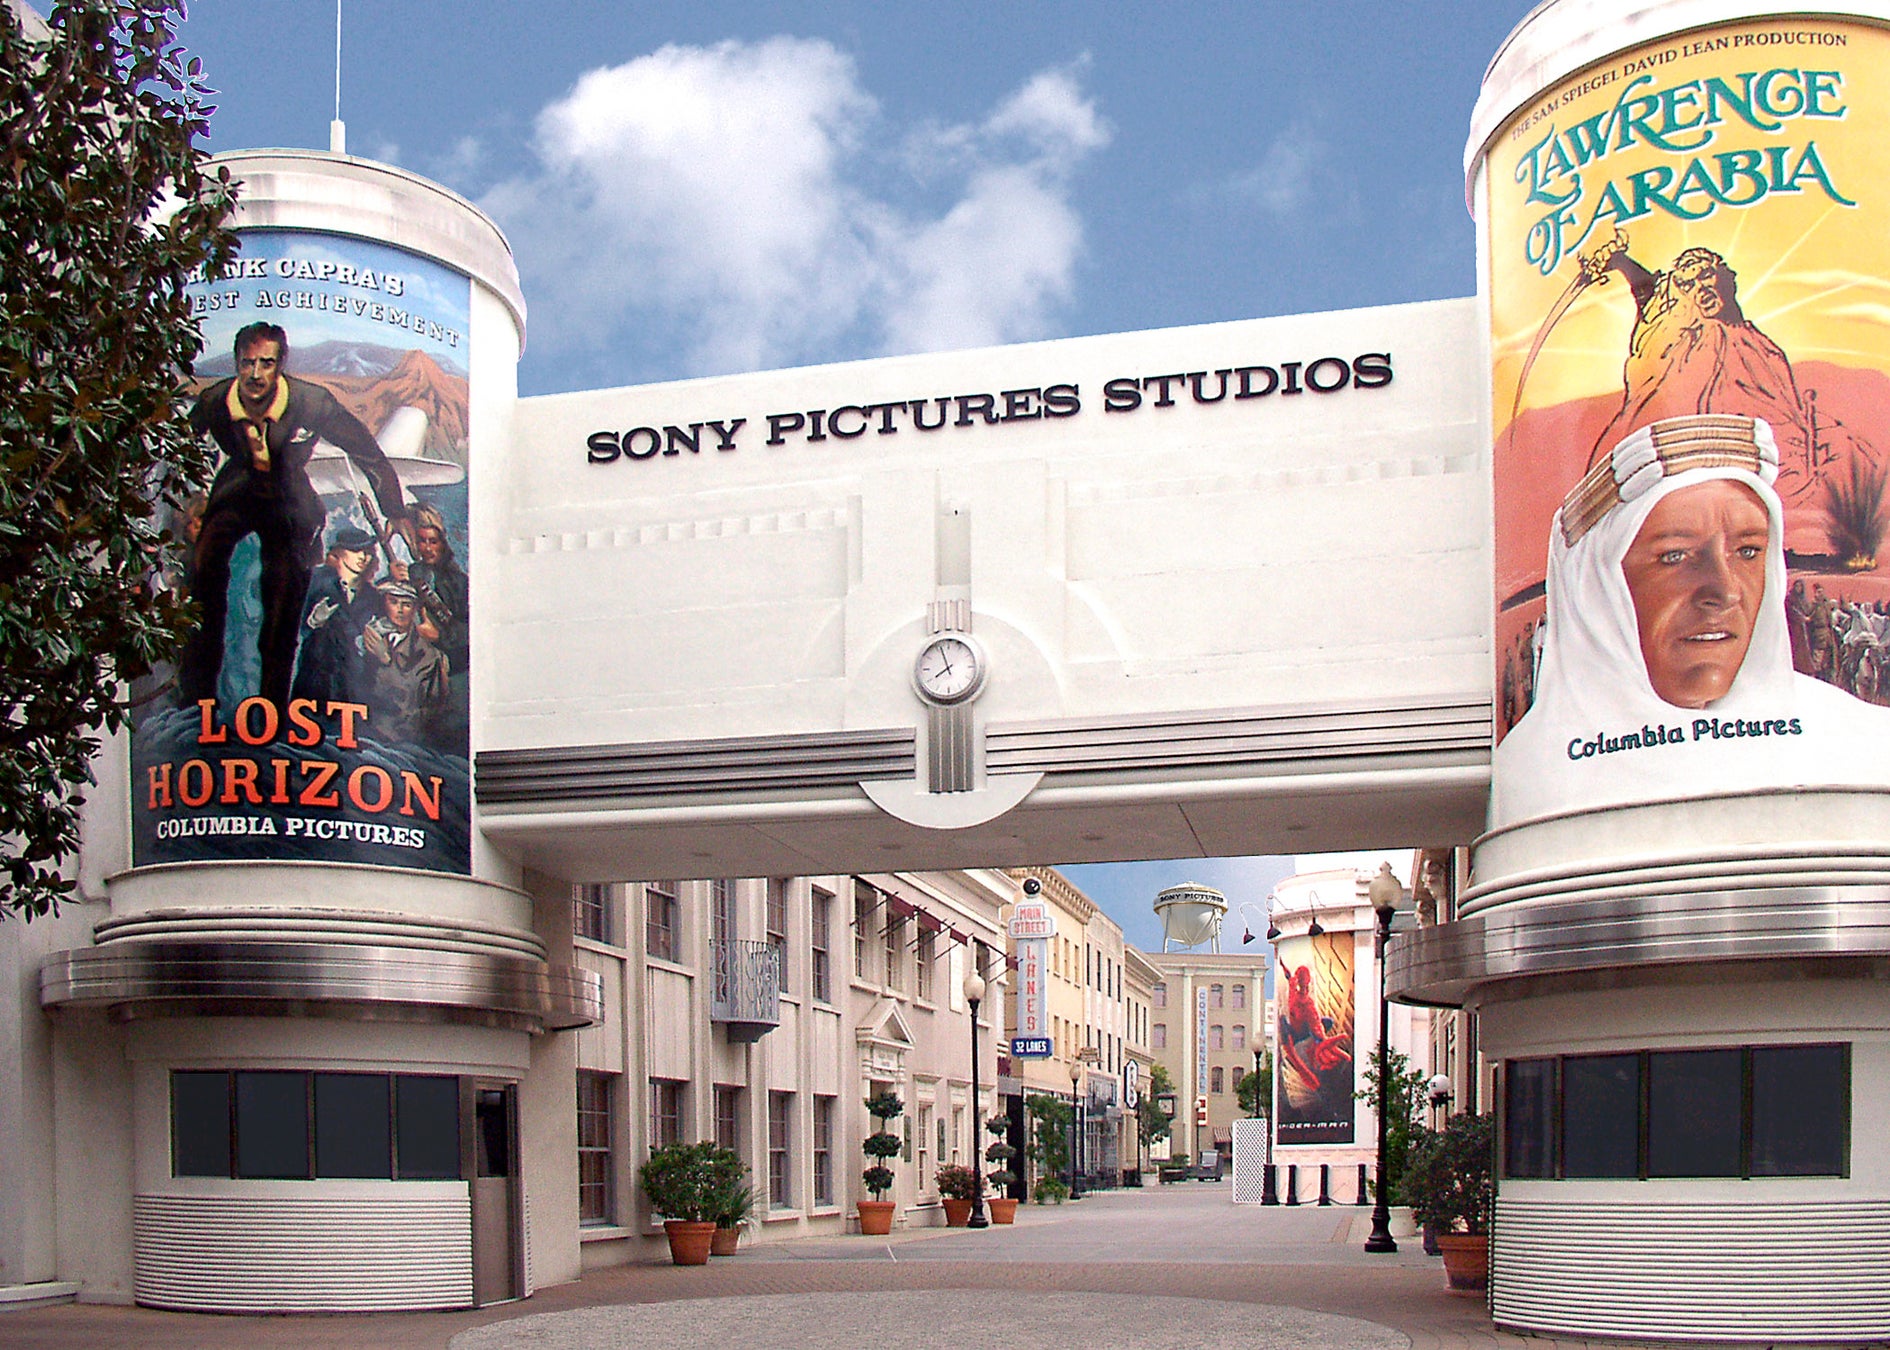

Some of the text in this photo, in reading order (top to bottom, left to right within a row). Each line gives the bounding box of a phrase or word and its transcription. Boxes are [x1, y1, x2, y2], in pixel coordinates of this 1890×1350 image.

[1511, 31, 1847, 141] THE SAM SPIEGEL DAVID LEAN PRODUCTION
[1515, 68, 1849, 205] LAWRENCE
[1524, 140, 1858, 276] OF ARABIA
[186, 258, 404, 296] RNK CAPRA'S
[194, 289, 460, 349] EST ACHIEVEMENT
[586, 353, 1394, 464] SONY PICTURES STUDIOS
[196, 696, 368, 748] LOST
[1567, 717, 1802, 761] Columbia Pictures
[147, 758, 444, 821] HORIZON
[157, 816, 426, 849] COLUMBIA PICTURES
[1019, 907, 1042, 920] MAIN
[1160, 893, 1224, 903] SONY PICTURES
[1014, 921, 1047, 934] STREET
[1026, 945, 1037, 1032] LANES
